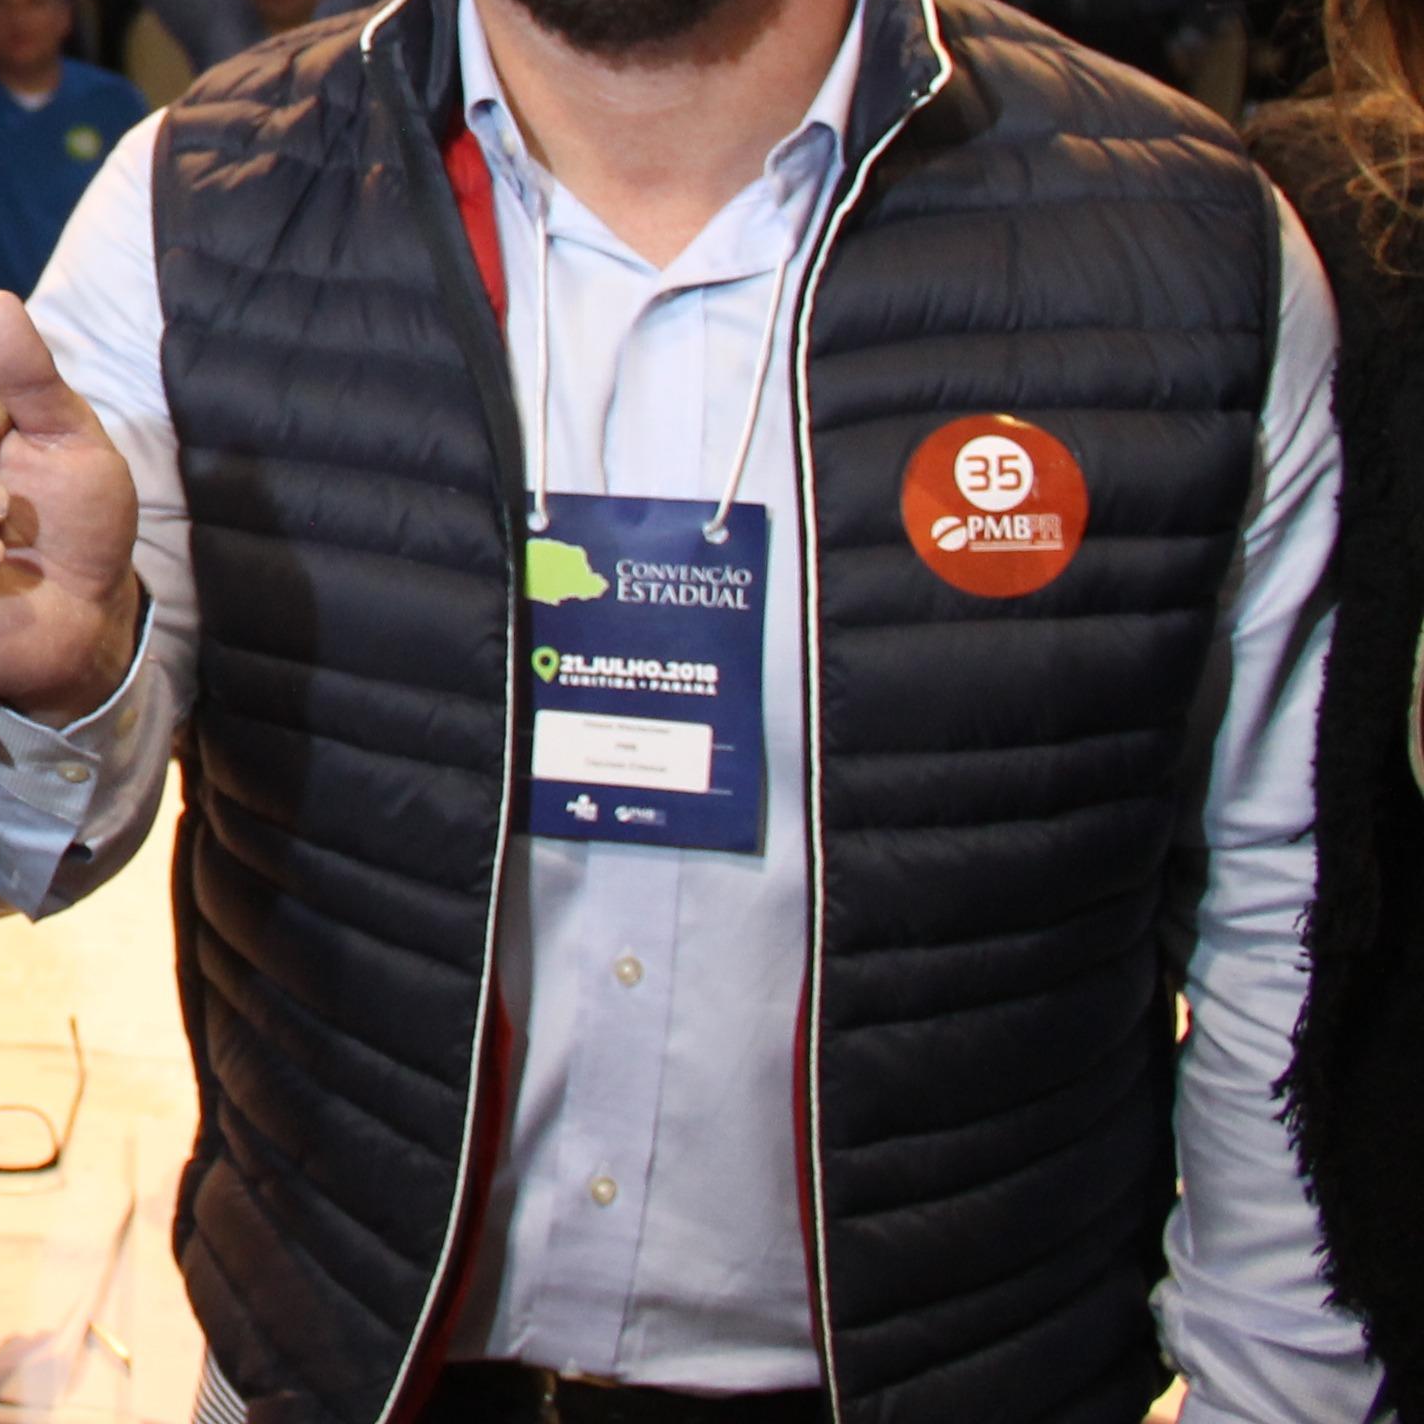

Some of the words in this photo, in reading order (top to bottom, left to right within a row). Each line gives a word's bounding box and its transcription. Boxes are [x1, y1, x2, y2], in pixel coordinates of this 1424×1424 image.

[964, 455, 1022, 491] 35
[616, 559, 752, 587] CONVENÇÃO
[616, 578, 750, 610] ESTADUAL
